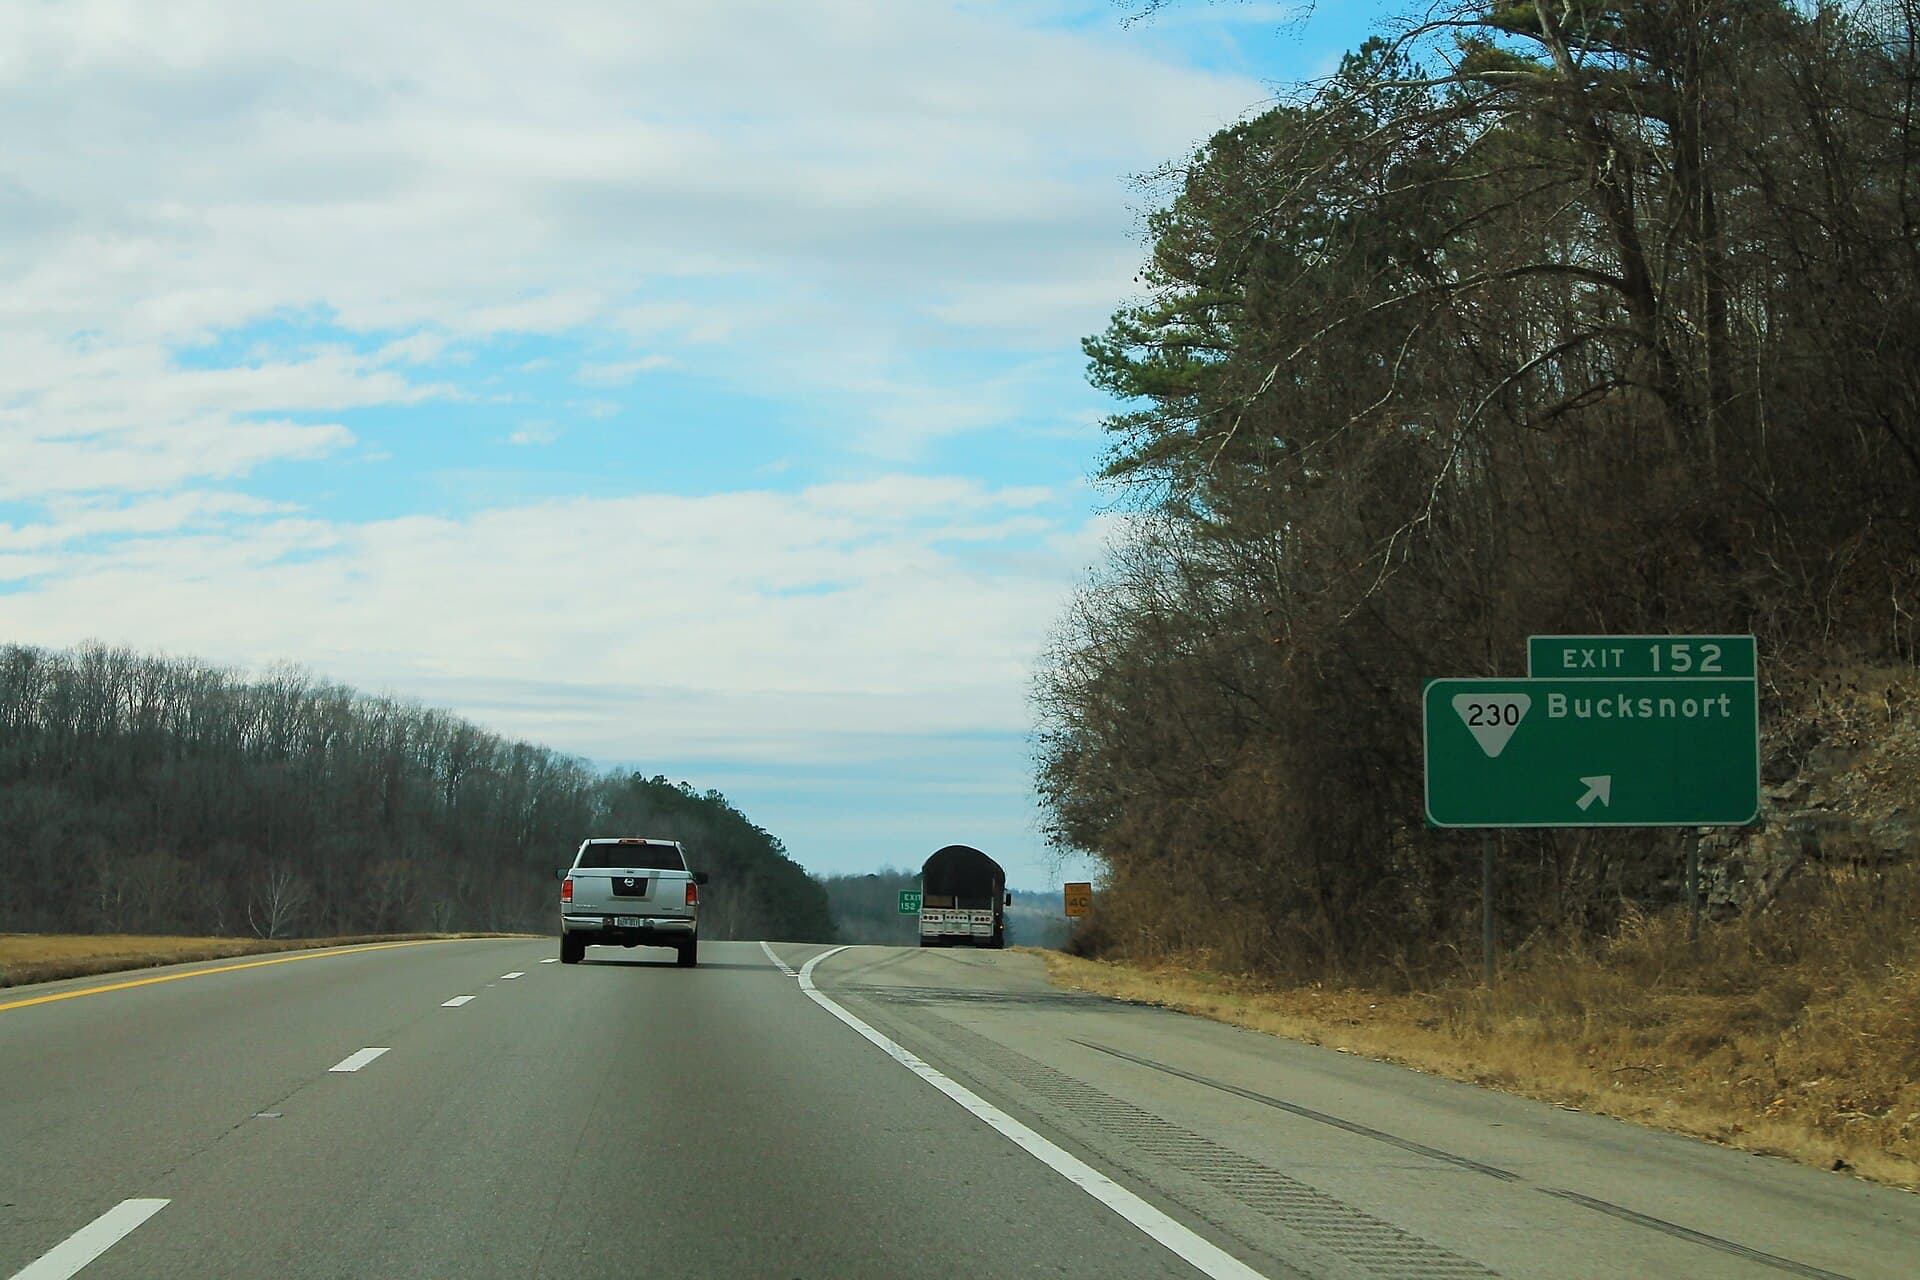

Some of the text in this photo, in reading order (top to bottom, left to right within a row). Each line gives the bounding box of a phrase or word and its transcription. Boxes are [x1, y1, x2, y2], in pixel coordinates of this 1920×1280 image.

[1563, 644, 1722, 672] EXIT 152
[1468, 703, 1520, 727] 230
[1548, 693, 1731, 718] Bucksnort
[901, 902, 916, 910] 152
